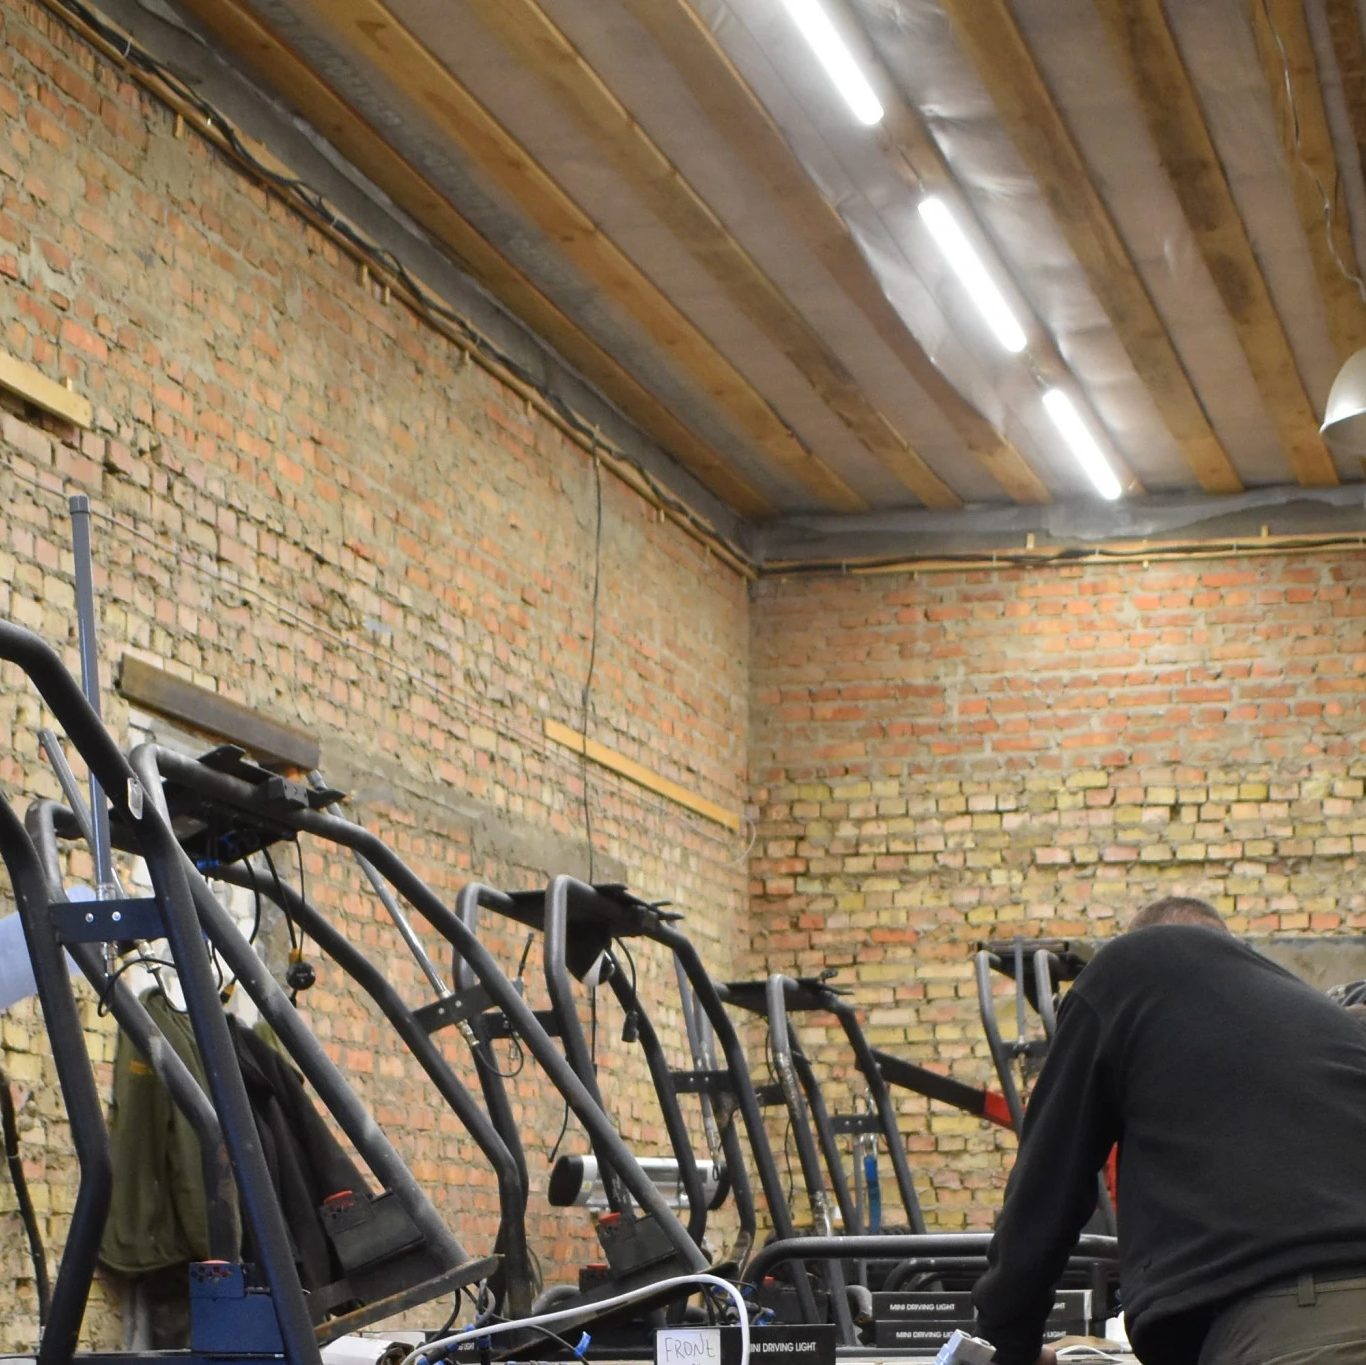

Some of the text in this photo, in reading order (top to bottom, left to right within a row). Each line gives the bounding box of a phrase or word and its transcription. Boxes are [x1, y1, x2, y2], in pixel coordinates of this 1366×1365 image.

[889, 1303, 956, 1311] MINI DRIVING LIGHT
[896, 1331, 912, 1339] MINI
[913, 1331, 942, 1339] DRIVING
[749, 1341, 817, 1353] INI DRIVING LIGHT
